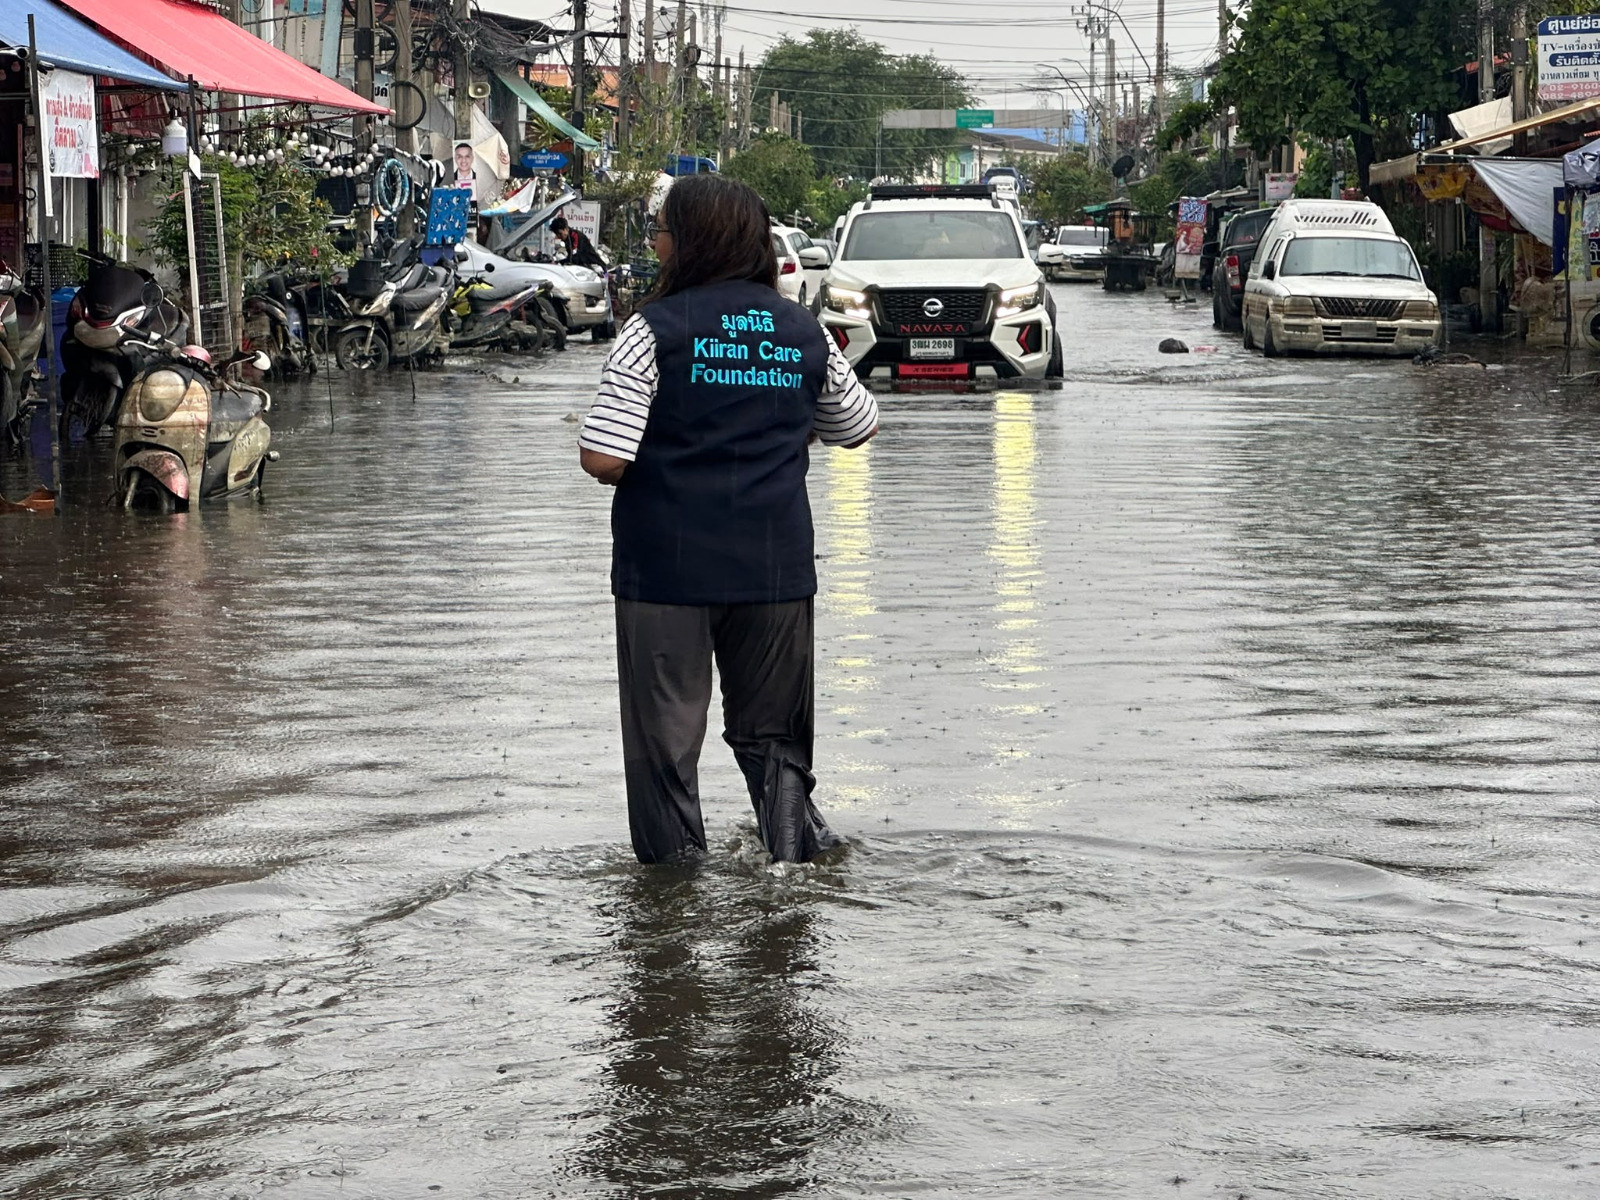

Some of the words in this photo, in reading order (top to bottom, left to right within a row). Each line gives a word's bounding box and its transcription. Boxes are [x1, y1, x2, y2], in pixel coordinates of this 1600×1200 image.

[1556, 53, 1600, 66] รับติดตั้
[721, 309, 775, 338] มูลนิธิ
[900, 324, 966, 332] NAVARA
[694, 337, 748, 360] Kiiran
[759, 340, 802, 362] Care
[691, 363, 803, 388] Foundation
